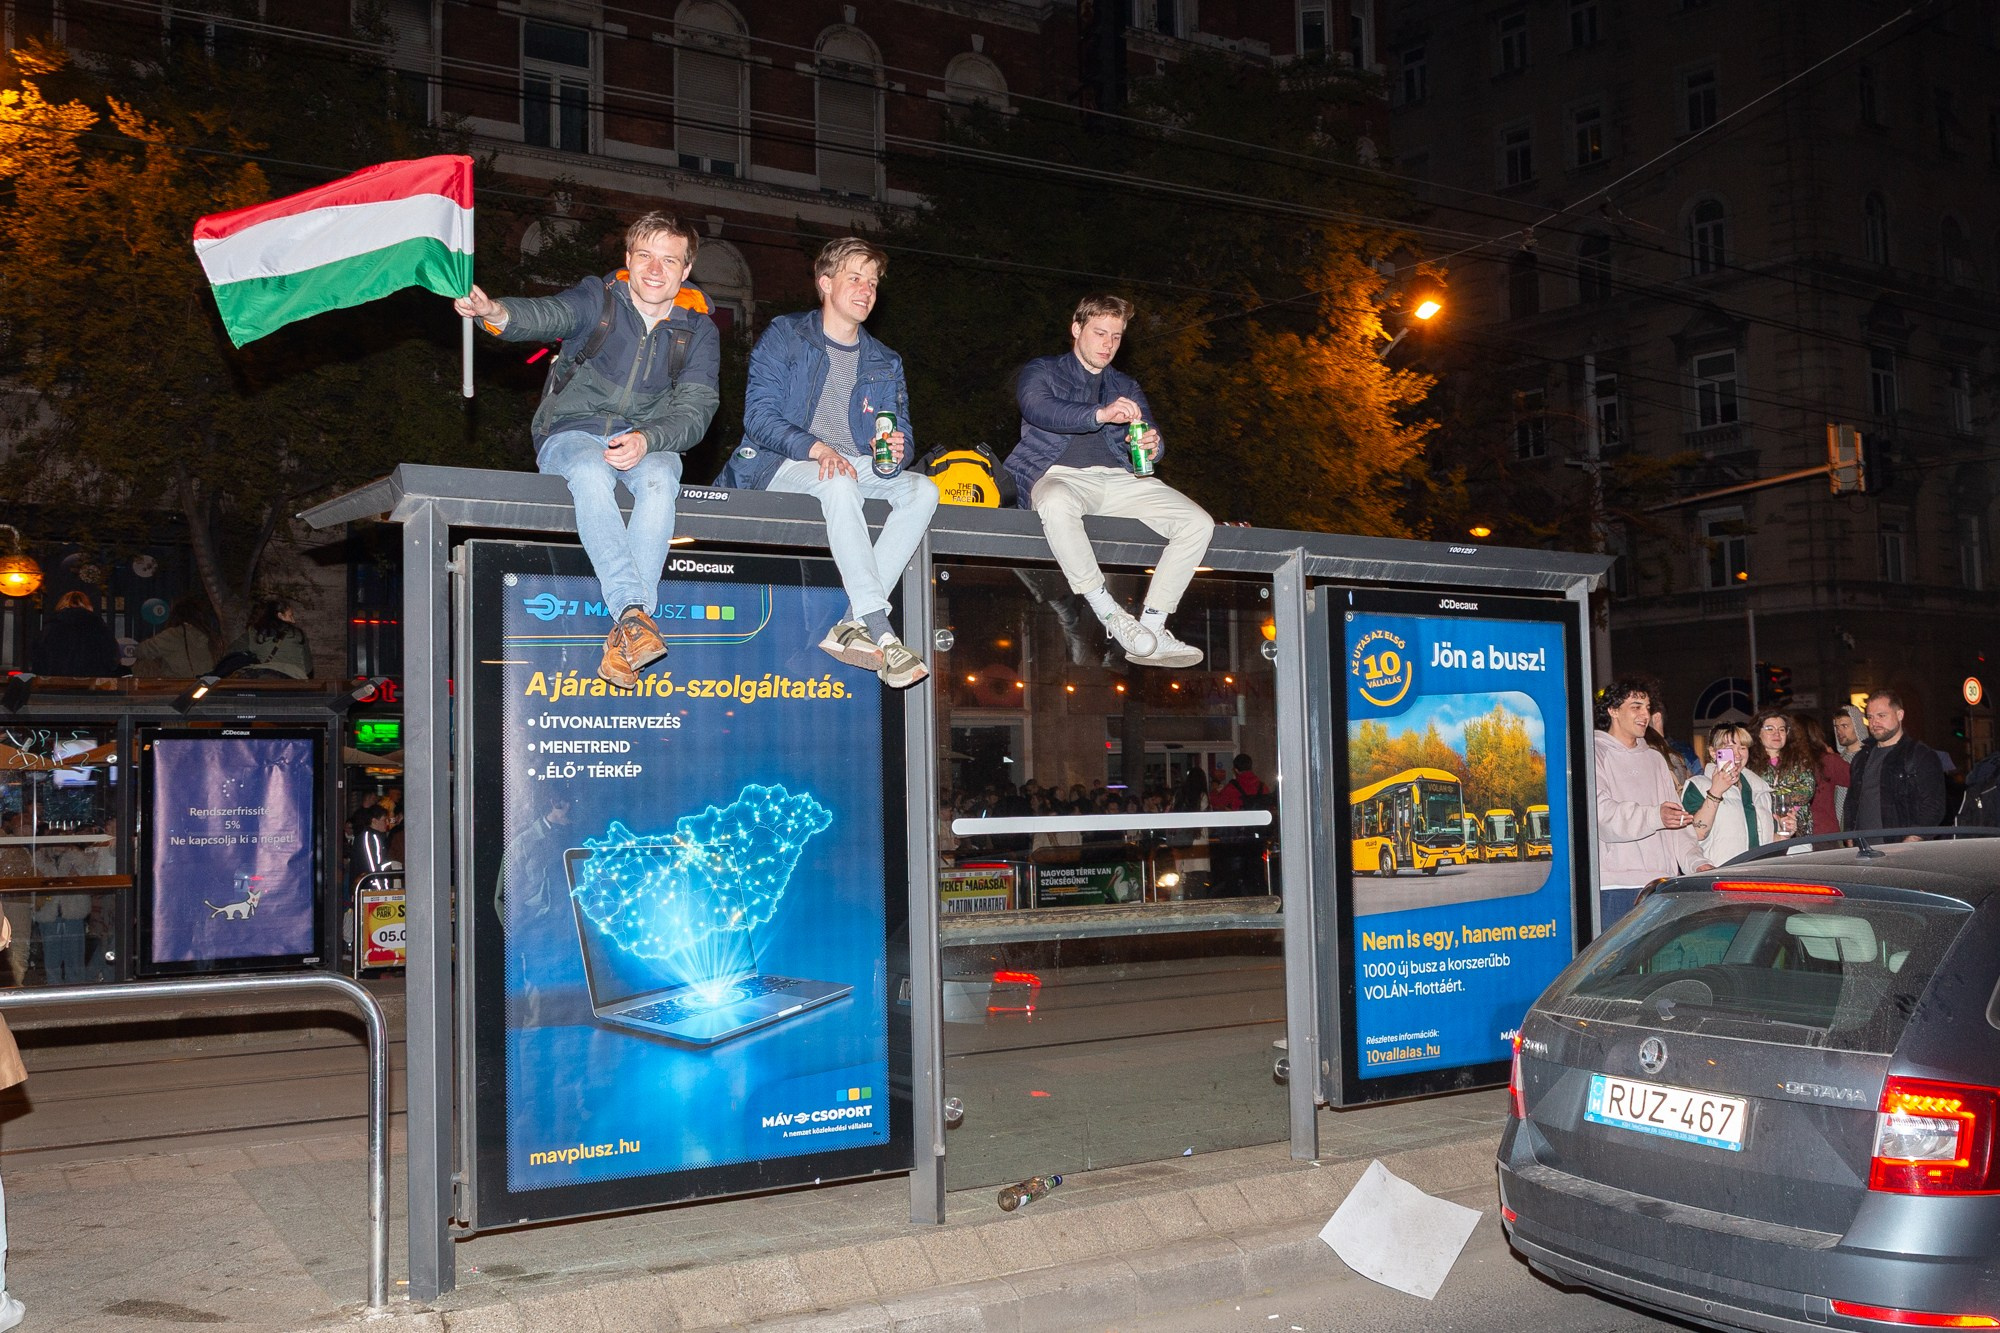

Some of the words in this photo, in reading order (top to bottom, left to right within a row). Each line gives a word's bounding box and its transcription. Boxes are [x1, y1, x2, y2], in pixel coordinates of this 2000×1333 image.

[683, 490, 729, 500] 1001296
[668, 560, 734, 574] JCDecaux
[1438, 599, 1478, 610] JCDecaux
[1353, 634, 1370, 658] UTAS
[1372, 630, 1384, 640] AZ
[1431, 641, 1467, 668] Jön
[1472, 650, 1484, 669] a
[1489, 644, 1546, 672] busz!
[1364, 651, 1400, 680] 10
[525, 671, 548, 696] A
[1366, 675, 1402, 688] VÁLLALÁS
[1968, 686, 1978, 696] 30
[539, 712, 681, 729] ÚTVONALTERVEZÉS
[540, 740, 630, 754] MENETREND
[588, 761, 642, 778] TÉRKÉP
[190, 806, 273, 817] Rendszerfrissíté
[225, 820, 240, 830] 5%
[170, 836, 186, 846] Ne
[188, 834, 236, 846] kapcsolja
[240, 834, 249, 844] ki
[1040, 868, 1074, 877] NAGYOBB
[1076, 867, 1096, 876] TÉRRE
[1040, 876, 1088, 886] SZÜKSÉGÜNK!
[377, 910, 392, 918] PARK
[1362, 932, 1404, 952] Nem
[1407, 929, 1420, 948] is
[1423, 930, 1459, 951] egy,
[1462, 925, 1516, 944] hanem
[1519, 919, 1556, 938] ezer!
[1363, 962, 1396, 978] 1000
[1398, 959, 1409, 978] új
[1411, 958, 1438, 974] busz
[1440, 962, 1446, 972] a
[1448, 953, 1510, 970] korszerűbb
[1364, 978, 1466, 1000] VOLÁN-flottáért.
[1366, 1034, 1398, 1045] Részletes
[1399, 1029, 1440, 1041] információk:
[1366, 1043, 1440, 1064] 10vallalas.hu
[1786, 1081, 1866, 1102] OCTAVIA
[762, 1112, 794, 1128] MÁV
[811, 1105, 872, 1122] CSOPORT
[1608, 1084, 1735, 1135] RUZ-467
[788, 1128, 812, 1137] nemzet
[812, 1124, 848, 1134] közlekedési
[848, 1122, 872, 1130] vállalata
[530, 1138, 640, 1166] mavplusz.hu
